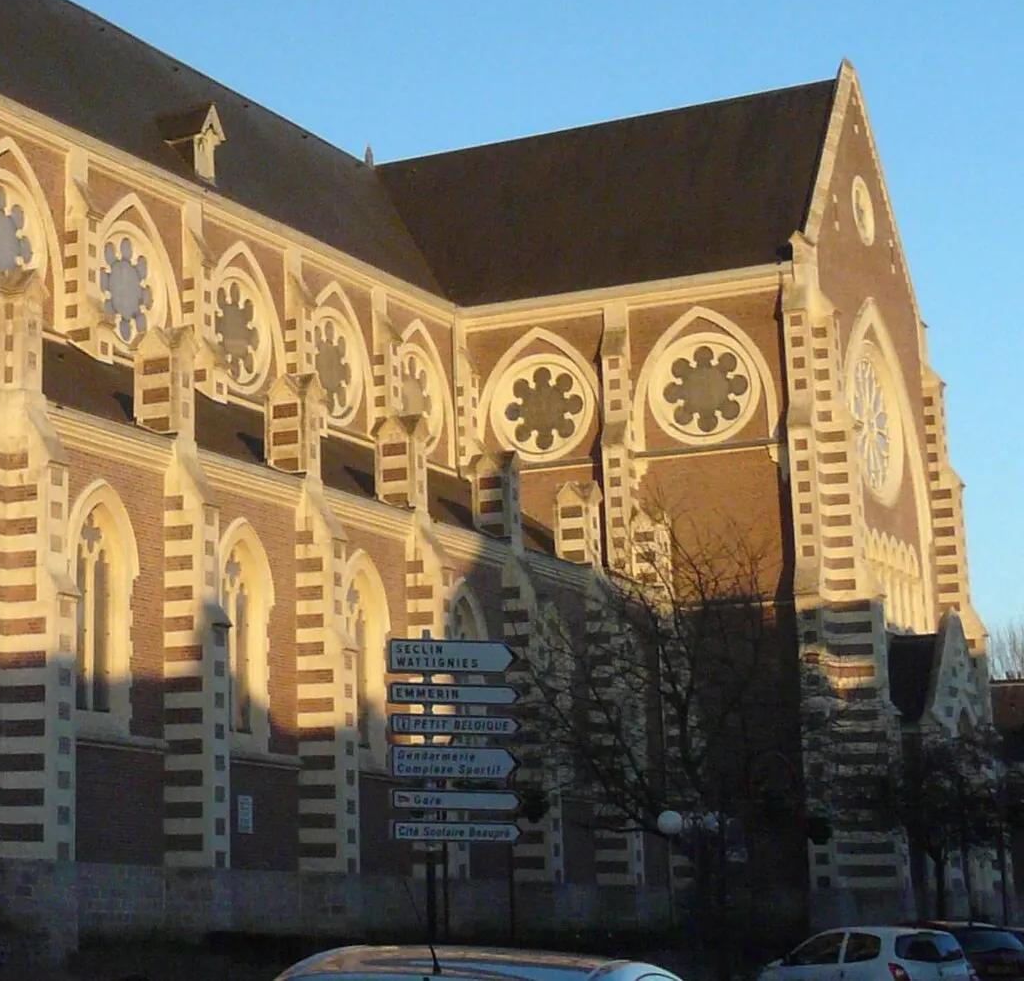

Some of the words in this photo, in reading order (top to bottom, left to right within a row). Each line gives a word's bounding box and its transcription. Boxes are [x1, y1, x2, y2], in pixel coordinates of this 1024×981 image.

[395, 644, 443, 654] SECLIN
[396, 657, 479, 668] WATTIGNIES
[395, 688, 460, 699] EMMERIN
[413, 718, 448, 729] PETIT
[397, 749, 475, 760] Gendarmerie
[397, 764, 453, 776] Complexe
[458, 764, 501, 776] Sportif
[413, 795, 441, 805] Gare
[423, 826, 465, 837] Scolaire
